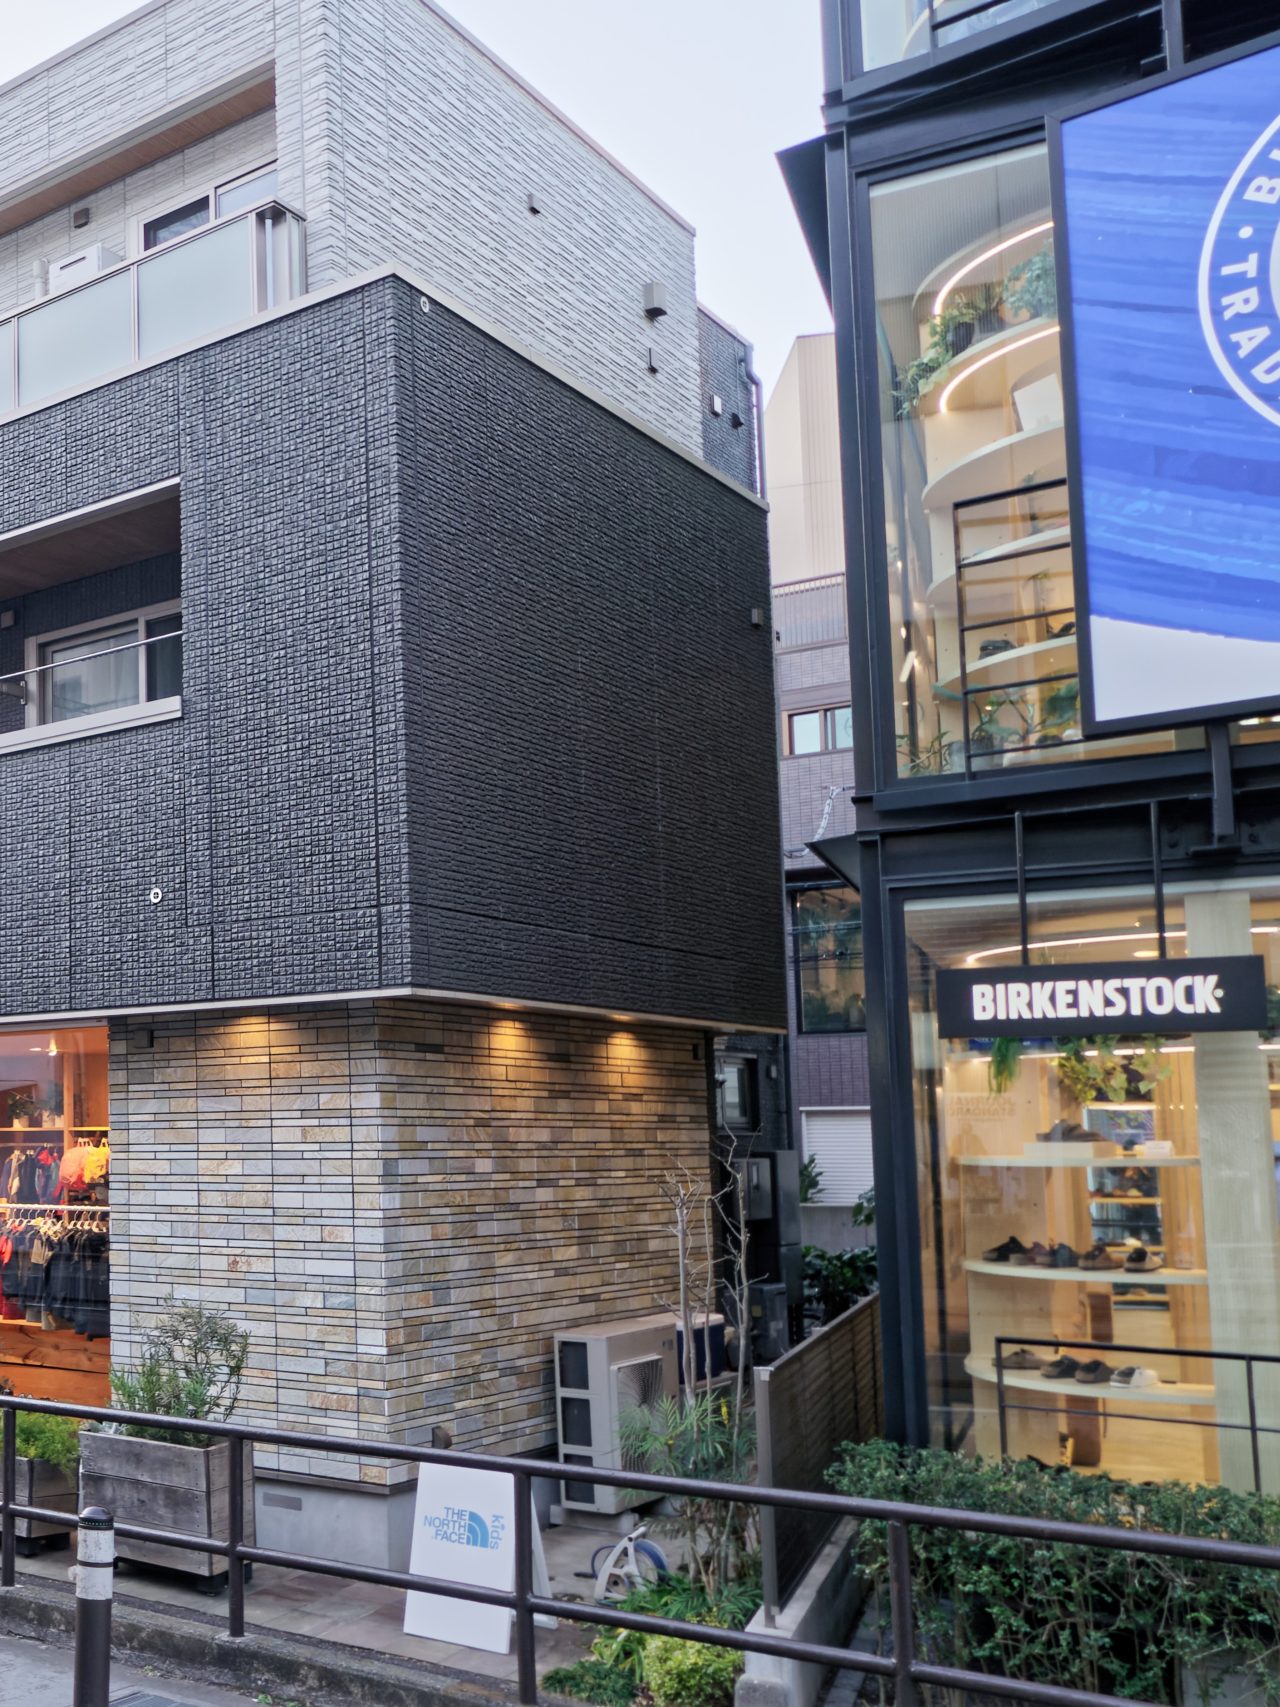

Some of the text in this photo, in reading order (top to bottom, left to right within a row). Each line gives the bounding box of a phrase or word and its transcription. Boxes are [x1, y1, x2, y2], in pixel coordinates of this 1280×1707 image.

[972, 974, 1222, 1020] BIRKENSTOCK
[444, 1507, 467, 1521] THE
[424, 1515, 466, 1532] NORTH
[490, 1514, 505, 1549] kids
[434, 1530, 465, 1544] FACE
